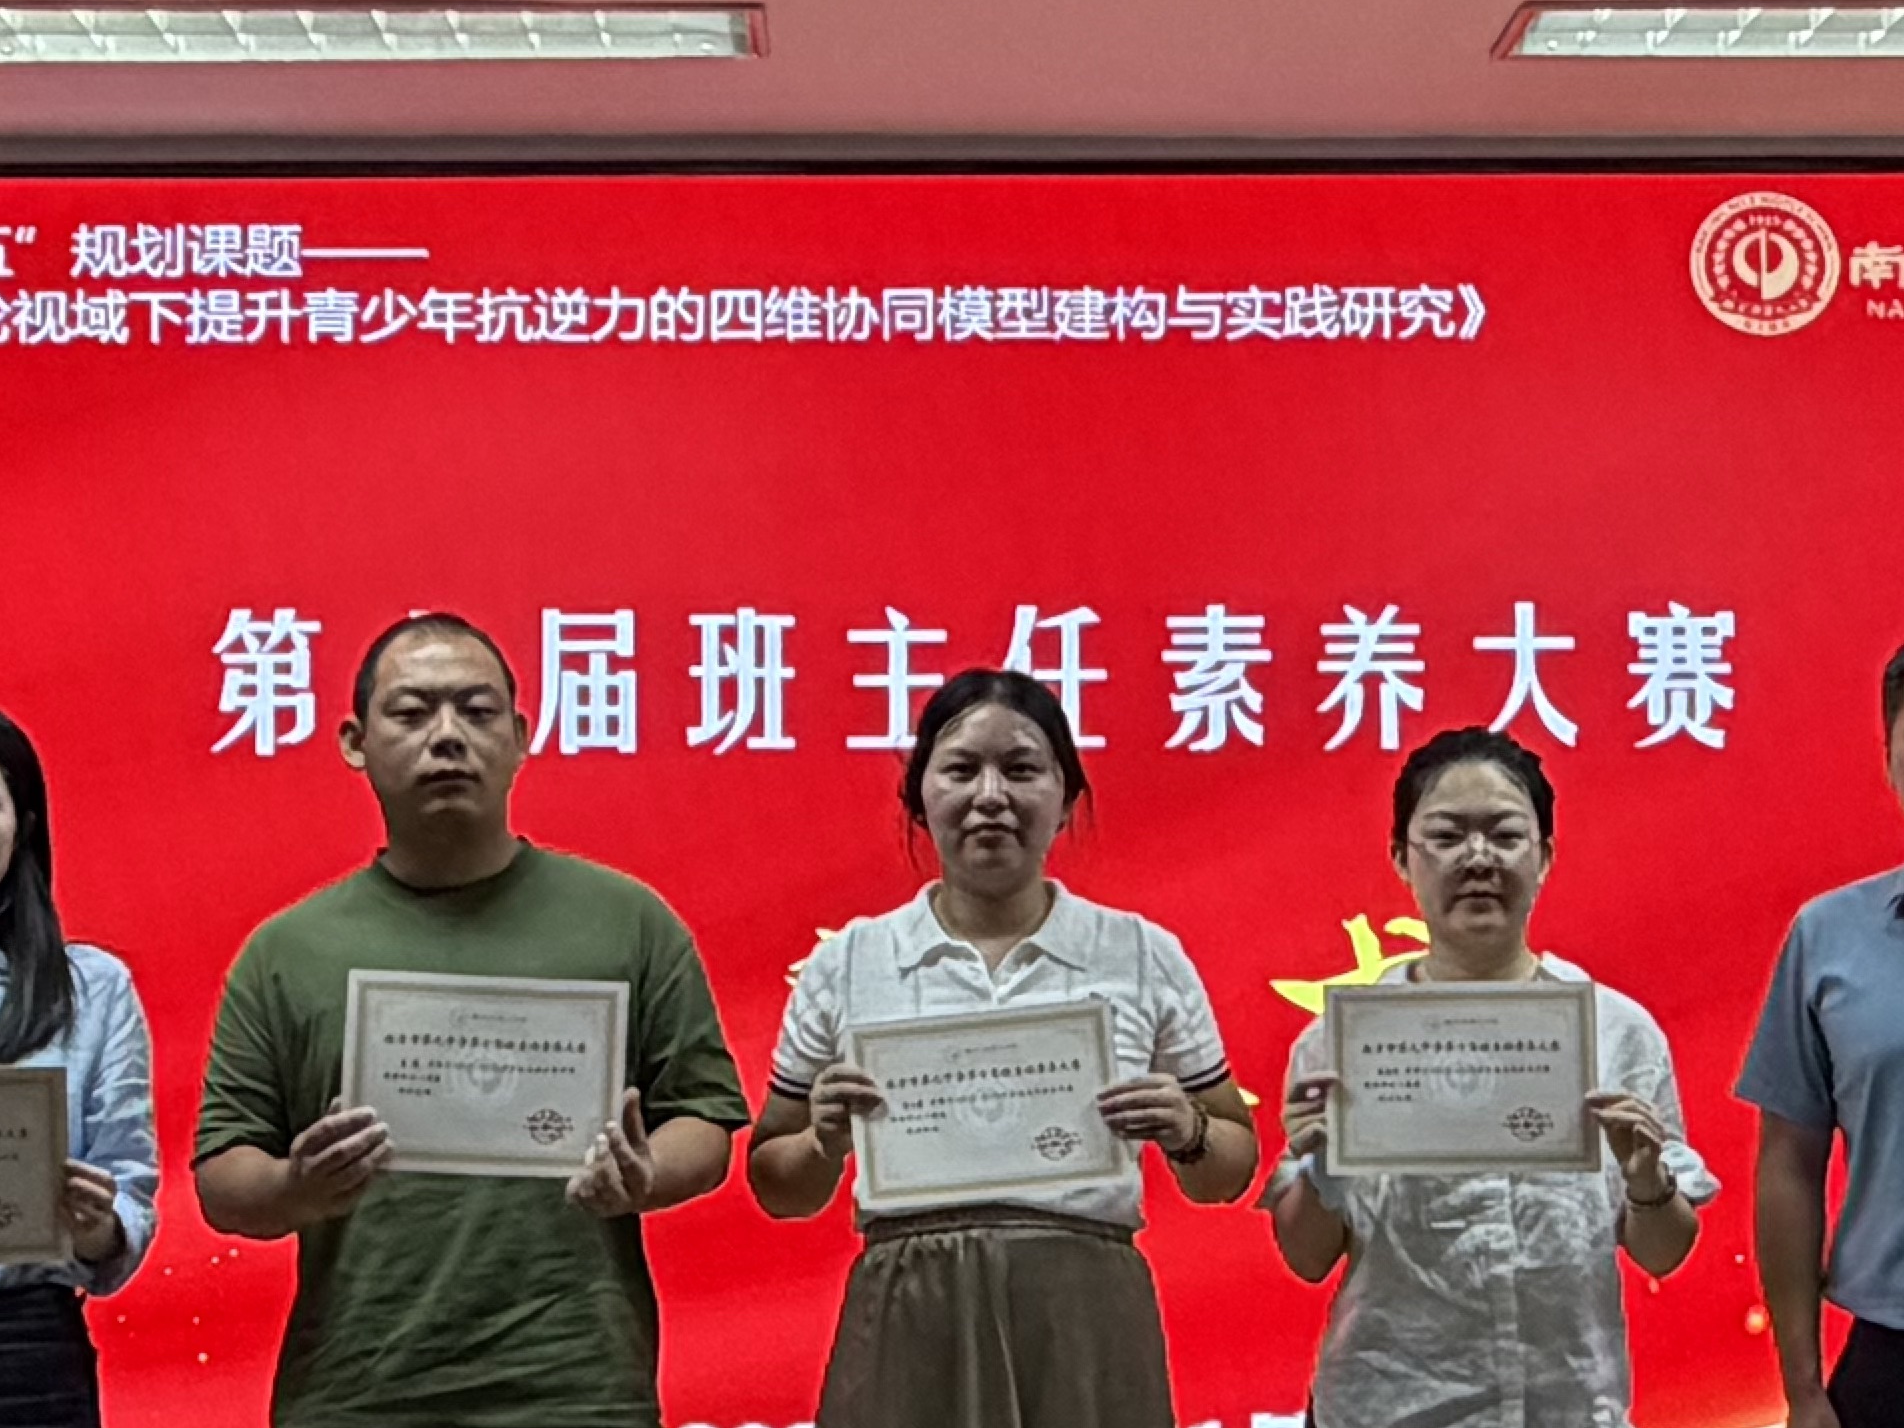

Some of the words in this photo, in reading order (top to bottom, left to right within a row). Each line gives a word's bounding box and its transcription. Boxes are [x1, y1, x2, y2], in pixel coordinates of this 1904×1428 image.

[210, 600, 1736, 756] 第届班主任素养大赛
